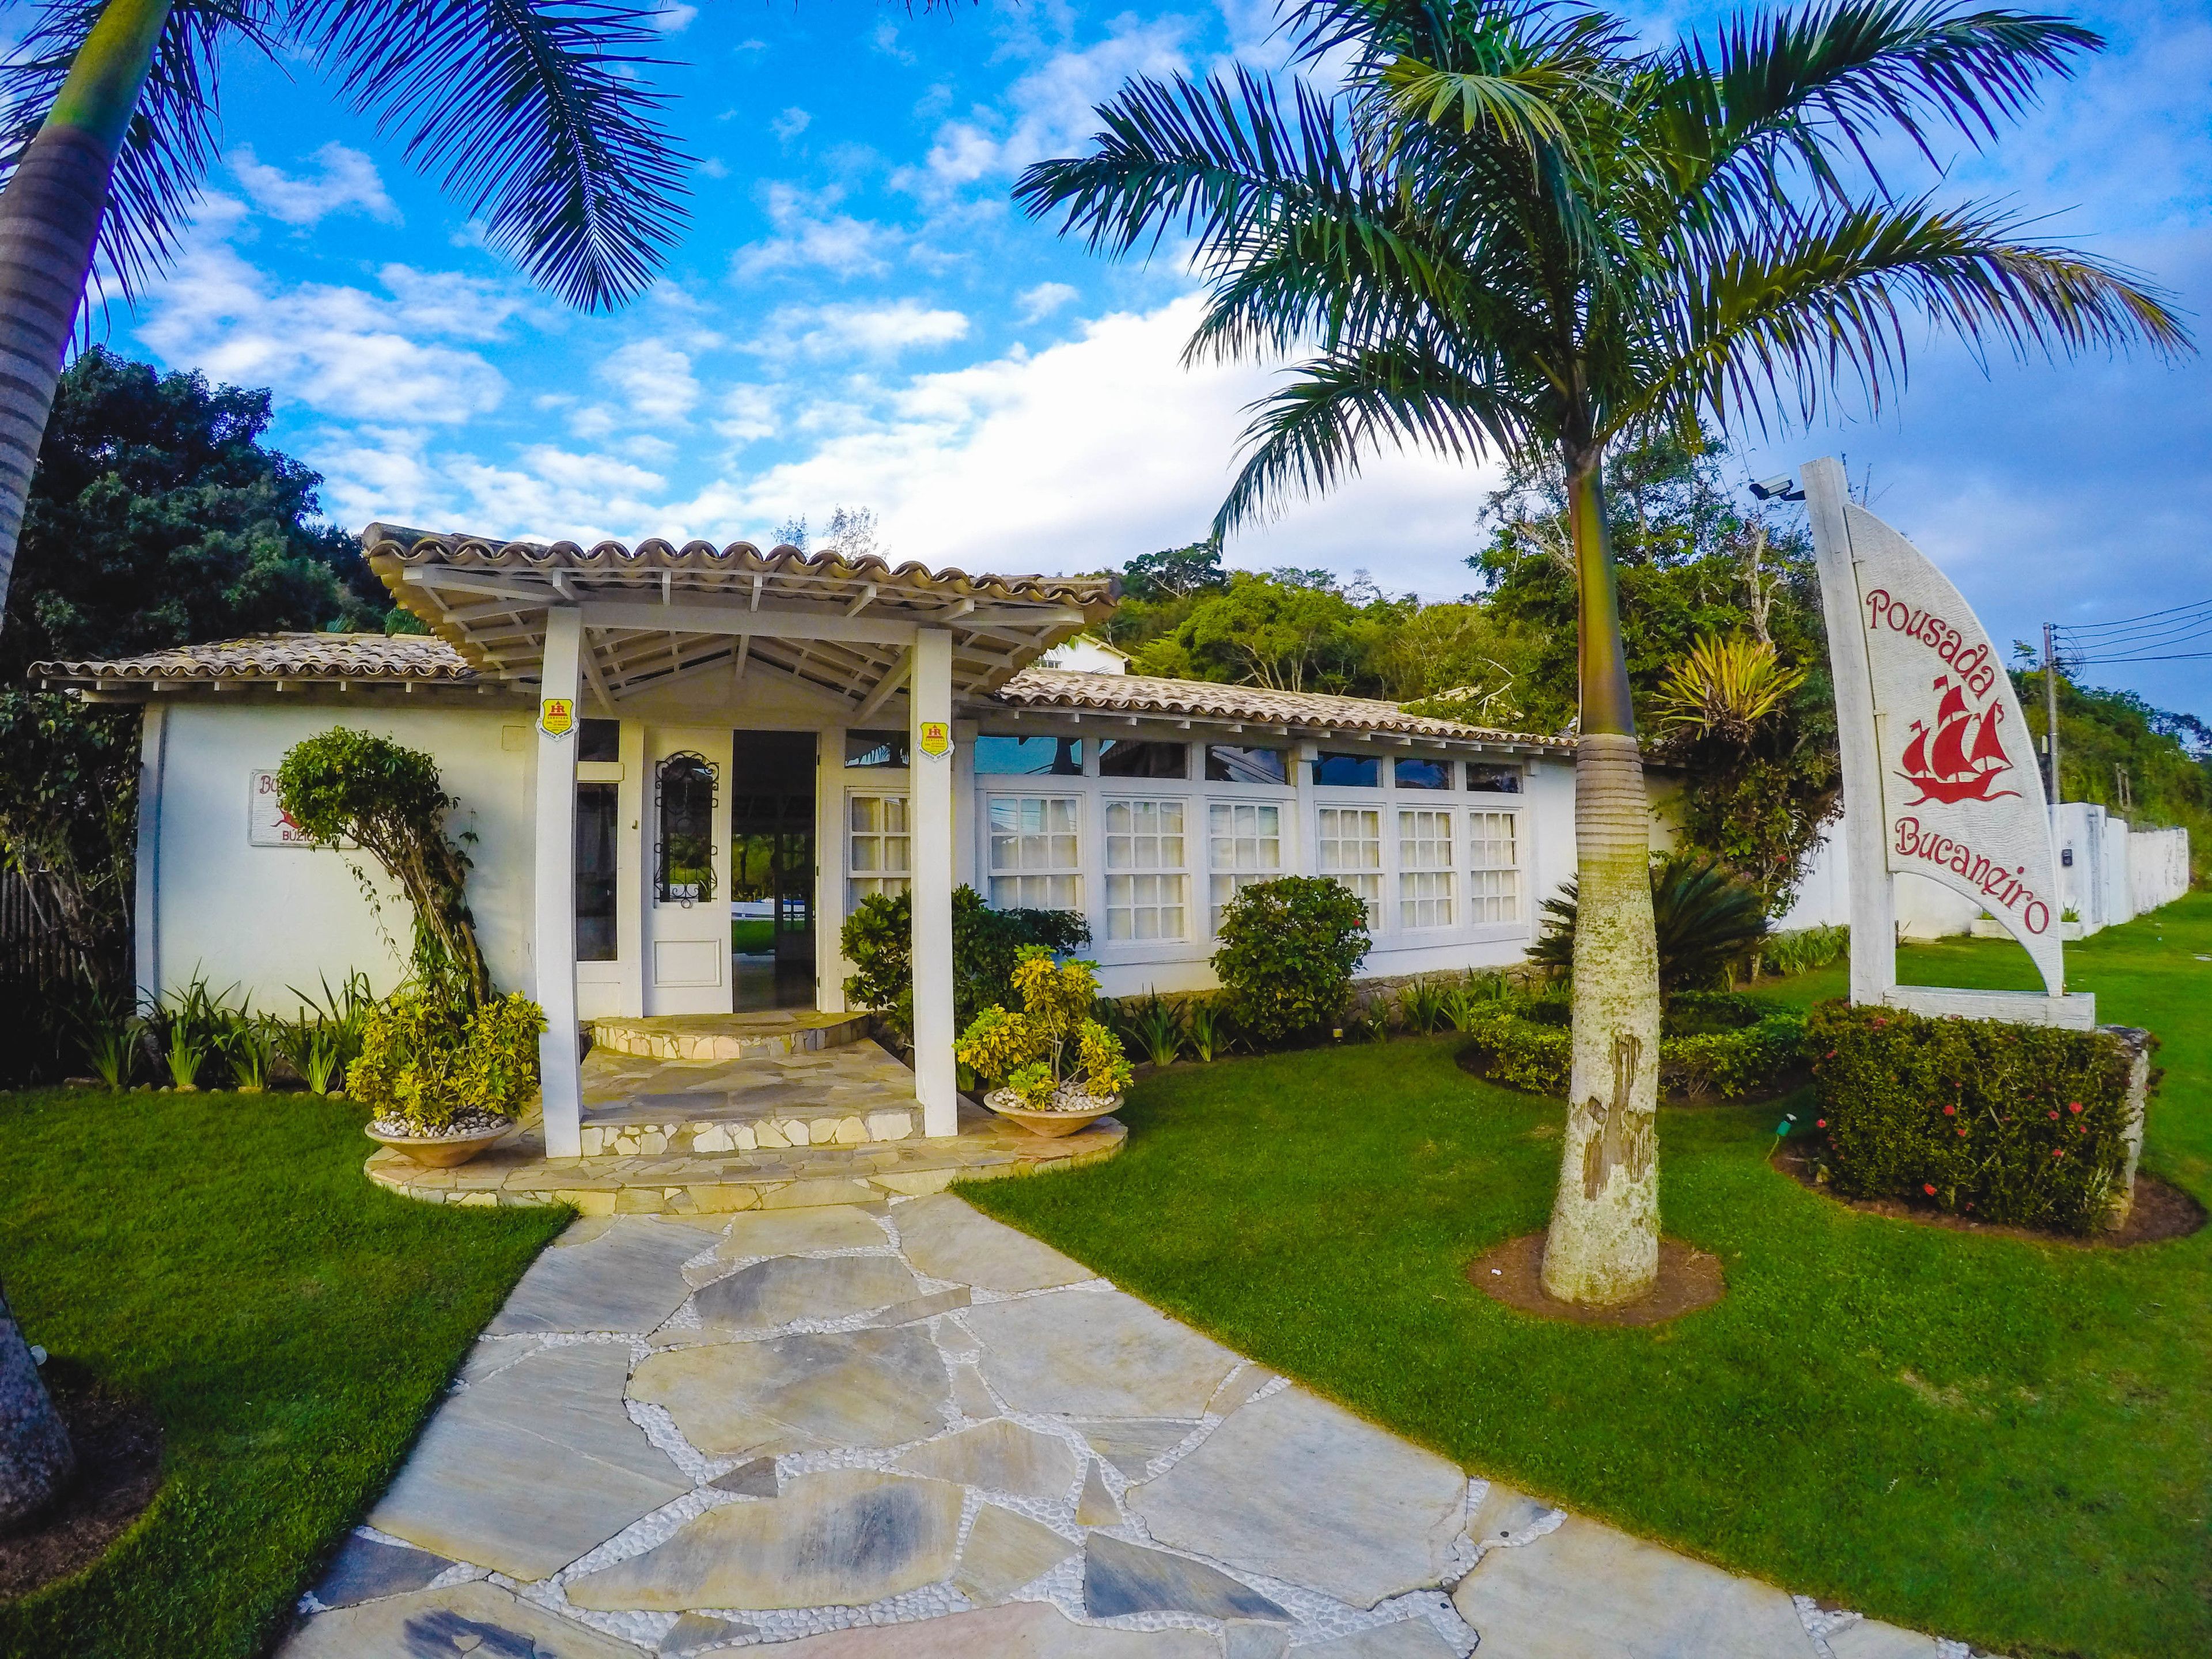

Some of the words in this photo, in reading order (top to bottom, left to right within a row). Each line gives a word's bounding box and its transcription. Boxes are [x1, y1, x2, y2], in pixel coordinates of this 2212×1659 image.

[1866, 589, 1995, 699] Pousada
[551, 704, 565, 713] HR
[929, 728, 942, 736] HR
[1895, 816, 2050, 935] Bucaneiro
